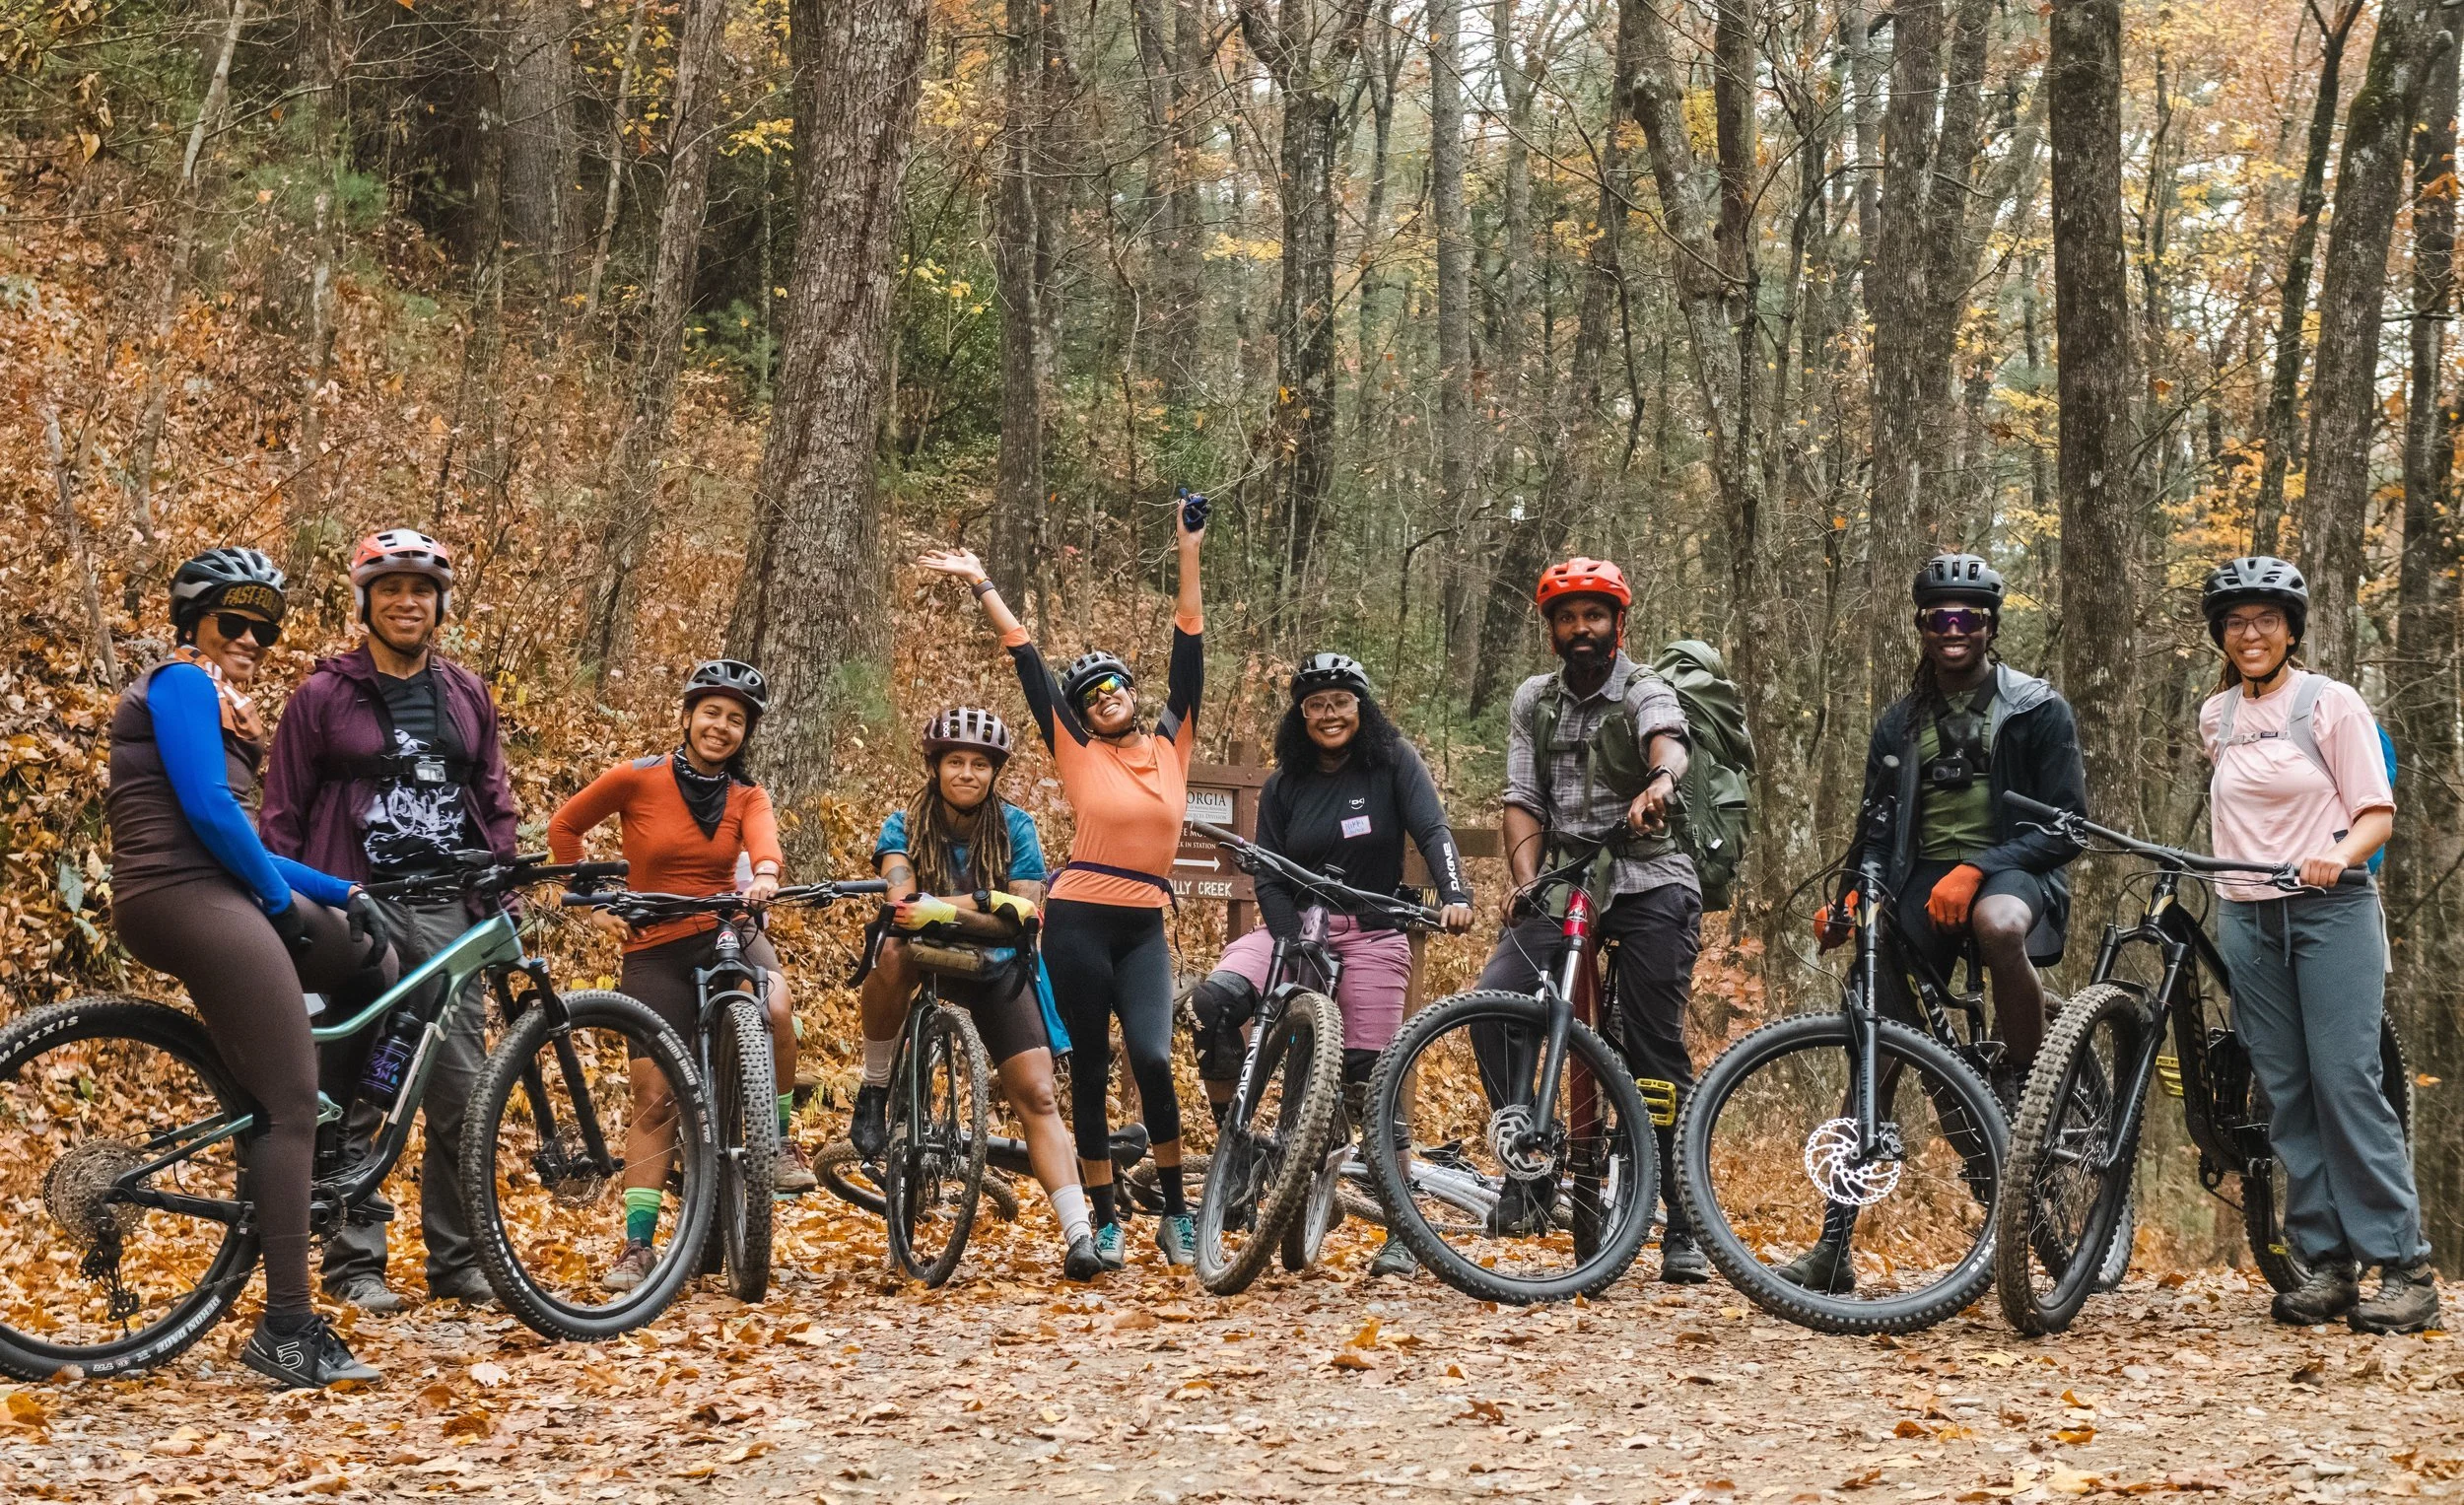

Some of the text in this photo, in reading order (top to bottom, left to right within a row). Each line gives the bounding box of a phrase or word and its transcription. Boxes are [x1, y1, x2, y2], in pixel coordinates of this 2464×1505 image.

[221, 585, 258, 606] FAST
[1187, 790, 1226, 806] ORGIA
[1443, 842, 1461, 892] DAKINE
[1198, 880, 1232, 898] CREEK
[0, 1015, 79, 1065] MAXXIS
[1969, 1232, 1997, 1272] XXIS
